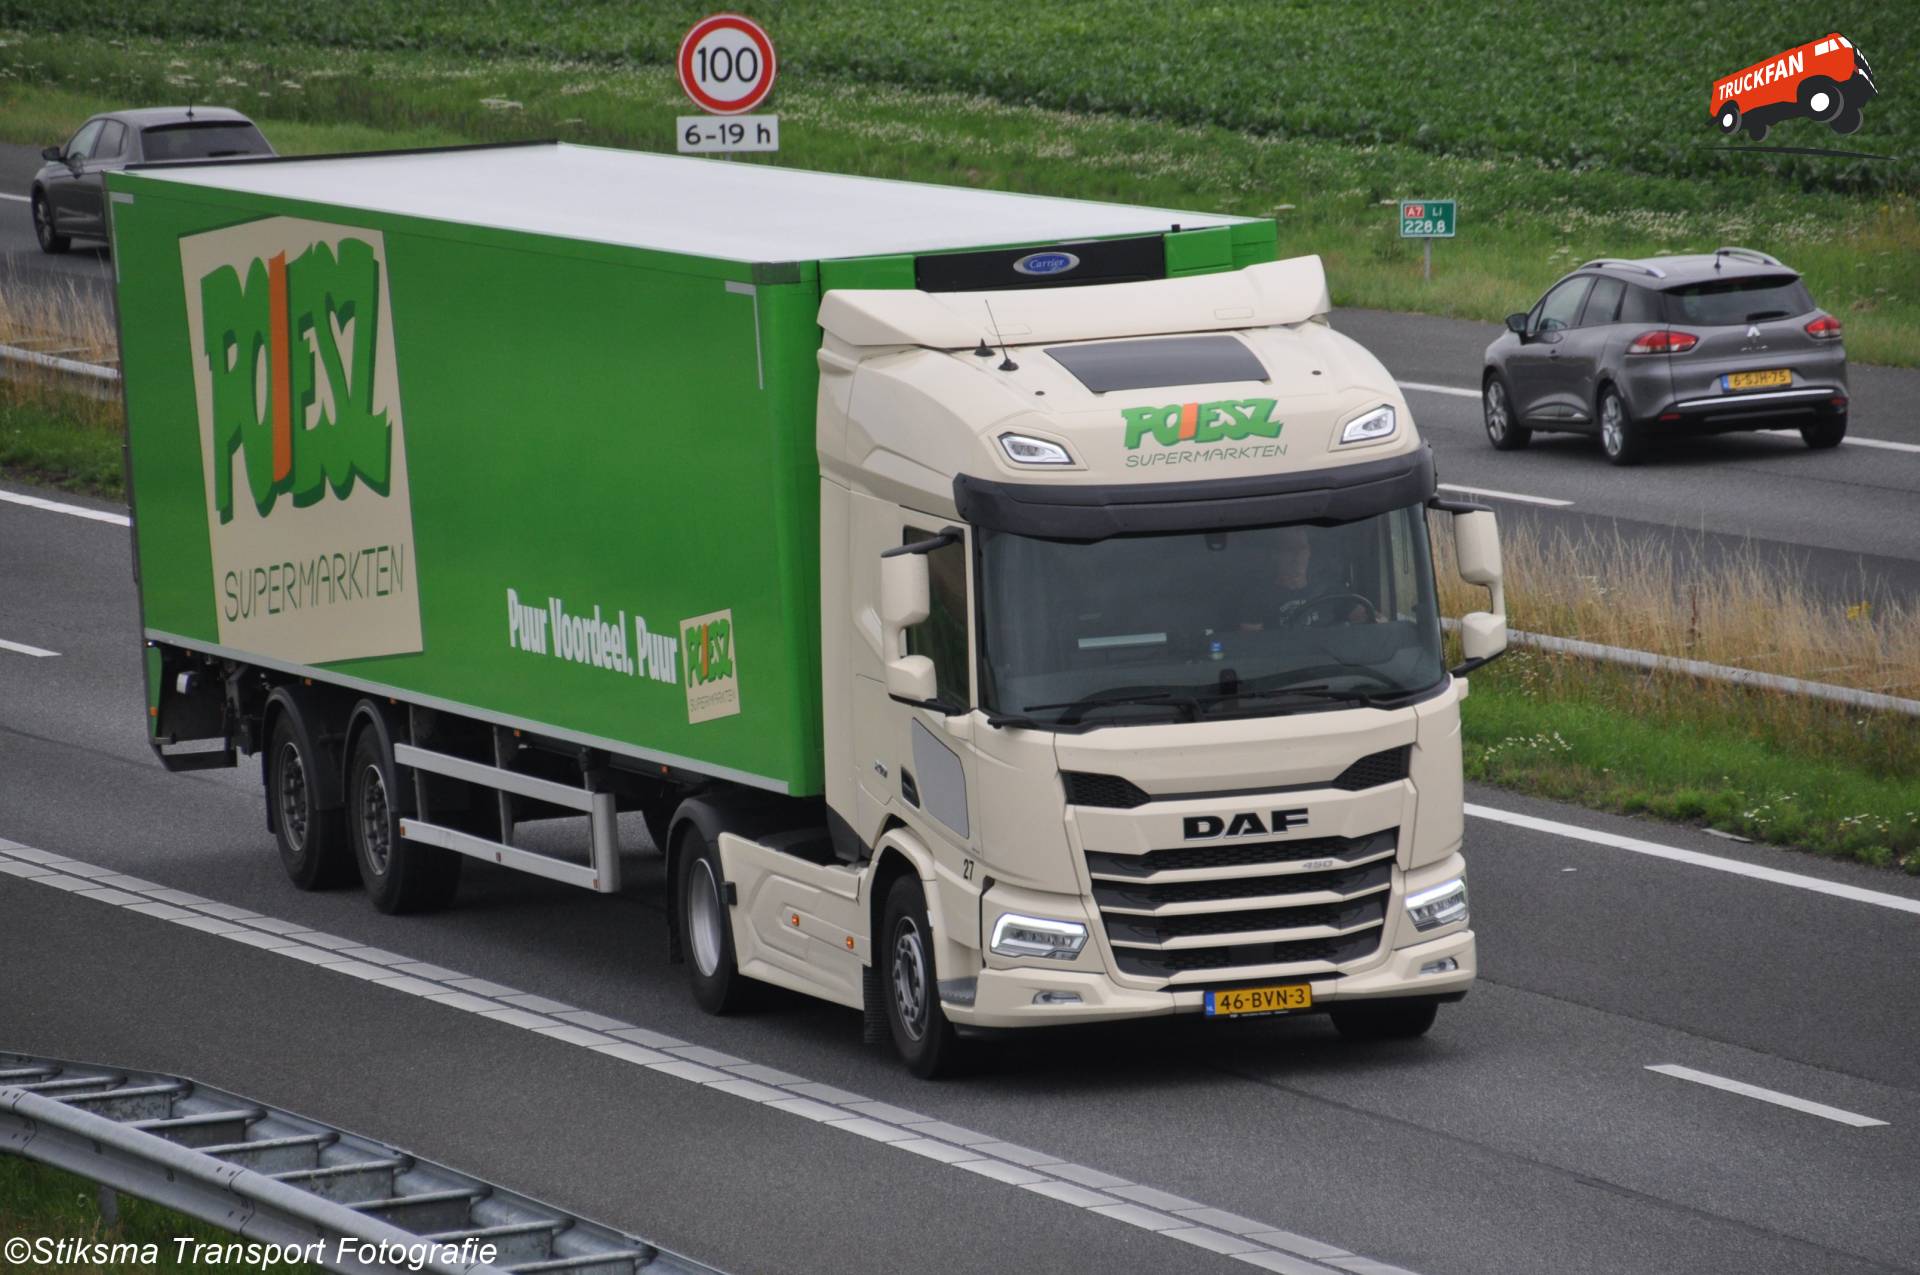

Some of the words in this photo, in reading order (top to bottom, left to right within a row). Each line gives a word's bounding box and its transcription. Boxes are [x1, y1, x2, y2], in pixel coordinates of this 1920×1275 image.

[698, 47, 758, 82] 100
[685, 123, 745, 145] 6-19
[757, 123, 771, 144] h
[1407, 207, 1422, 217] A7
[200, 237, 392, 526] POIESZ
[1121, 398, 1284, 450] POIESZ
[1125, 444, 1288, 468] SUPERMARKTEN
[224, 544, 404, 622] SUPERMARKTEN
[506, 588, 547, 655] Puur
[549, 597, 634, 676] Voordeel.
[635, 615, 677, 684] Puur
[685, 618, 733, 688] POIESZ
[1183, 808, 1309, 840] DAF
[963, 858, 975, 880] 27
[1220, 988, 1305, 1010] 46-BVN-3
